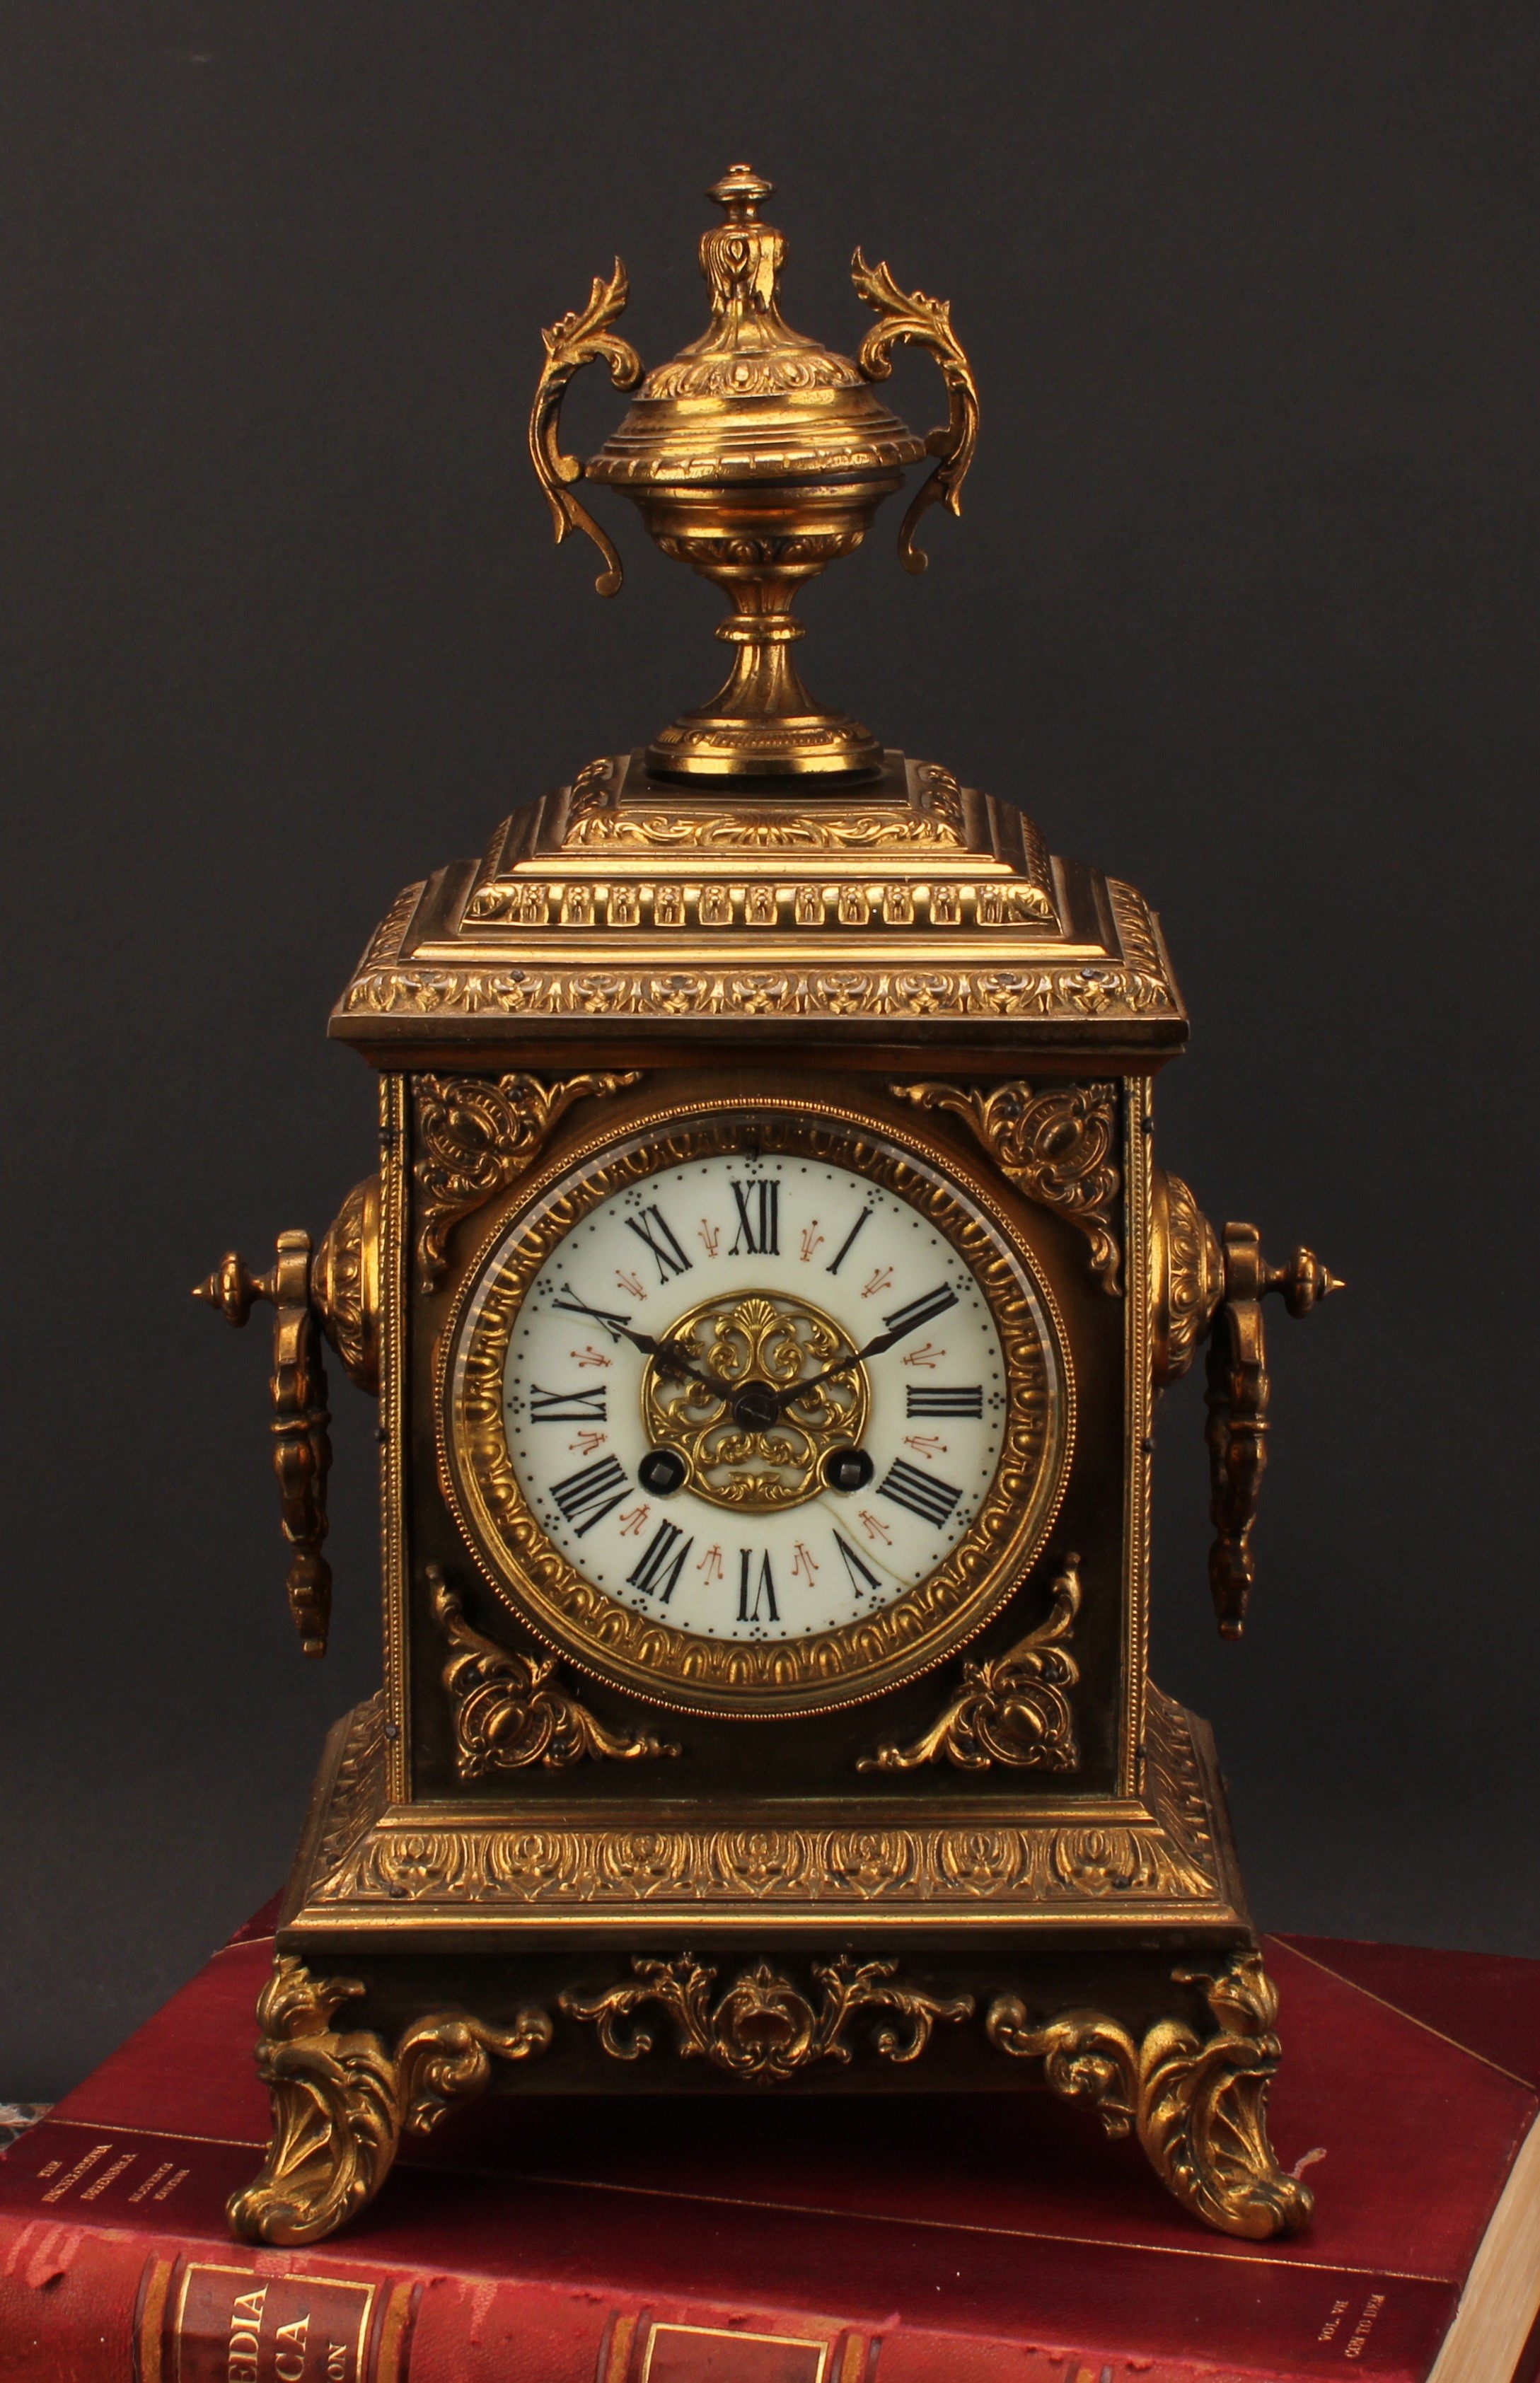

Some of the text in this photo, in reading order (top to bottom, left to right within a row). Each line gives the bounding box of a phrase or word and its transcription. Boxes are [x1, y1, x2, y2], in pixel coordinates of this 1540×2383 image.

[624, 1204, 694, 1285] XI
[728, 1180, 780, 1256] XII
[826, 1206, 874, 1275] I
[552, 1282, 632, 1343] X
[881, 1281, 959, 1332] II
[531, 1384, 607, 1424] IX
[905, 1384, 983, 1419] III
[549, 1454, 635, 1538] VIII
[876, 1458, 963, 1529] IIII
[625, 1519, 695, 1604] VII
[736, 1548, 780, 1622] VI
[831, 1528, 882, 1599] V
[1355, 2320, 1372, 2334] TO
